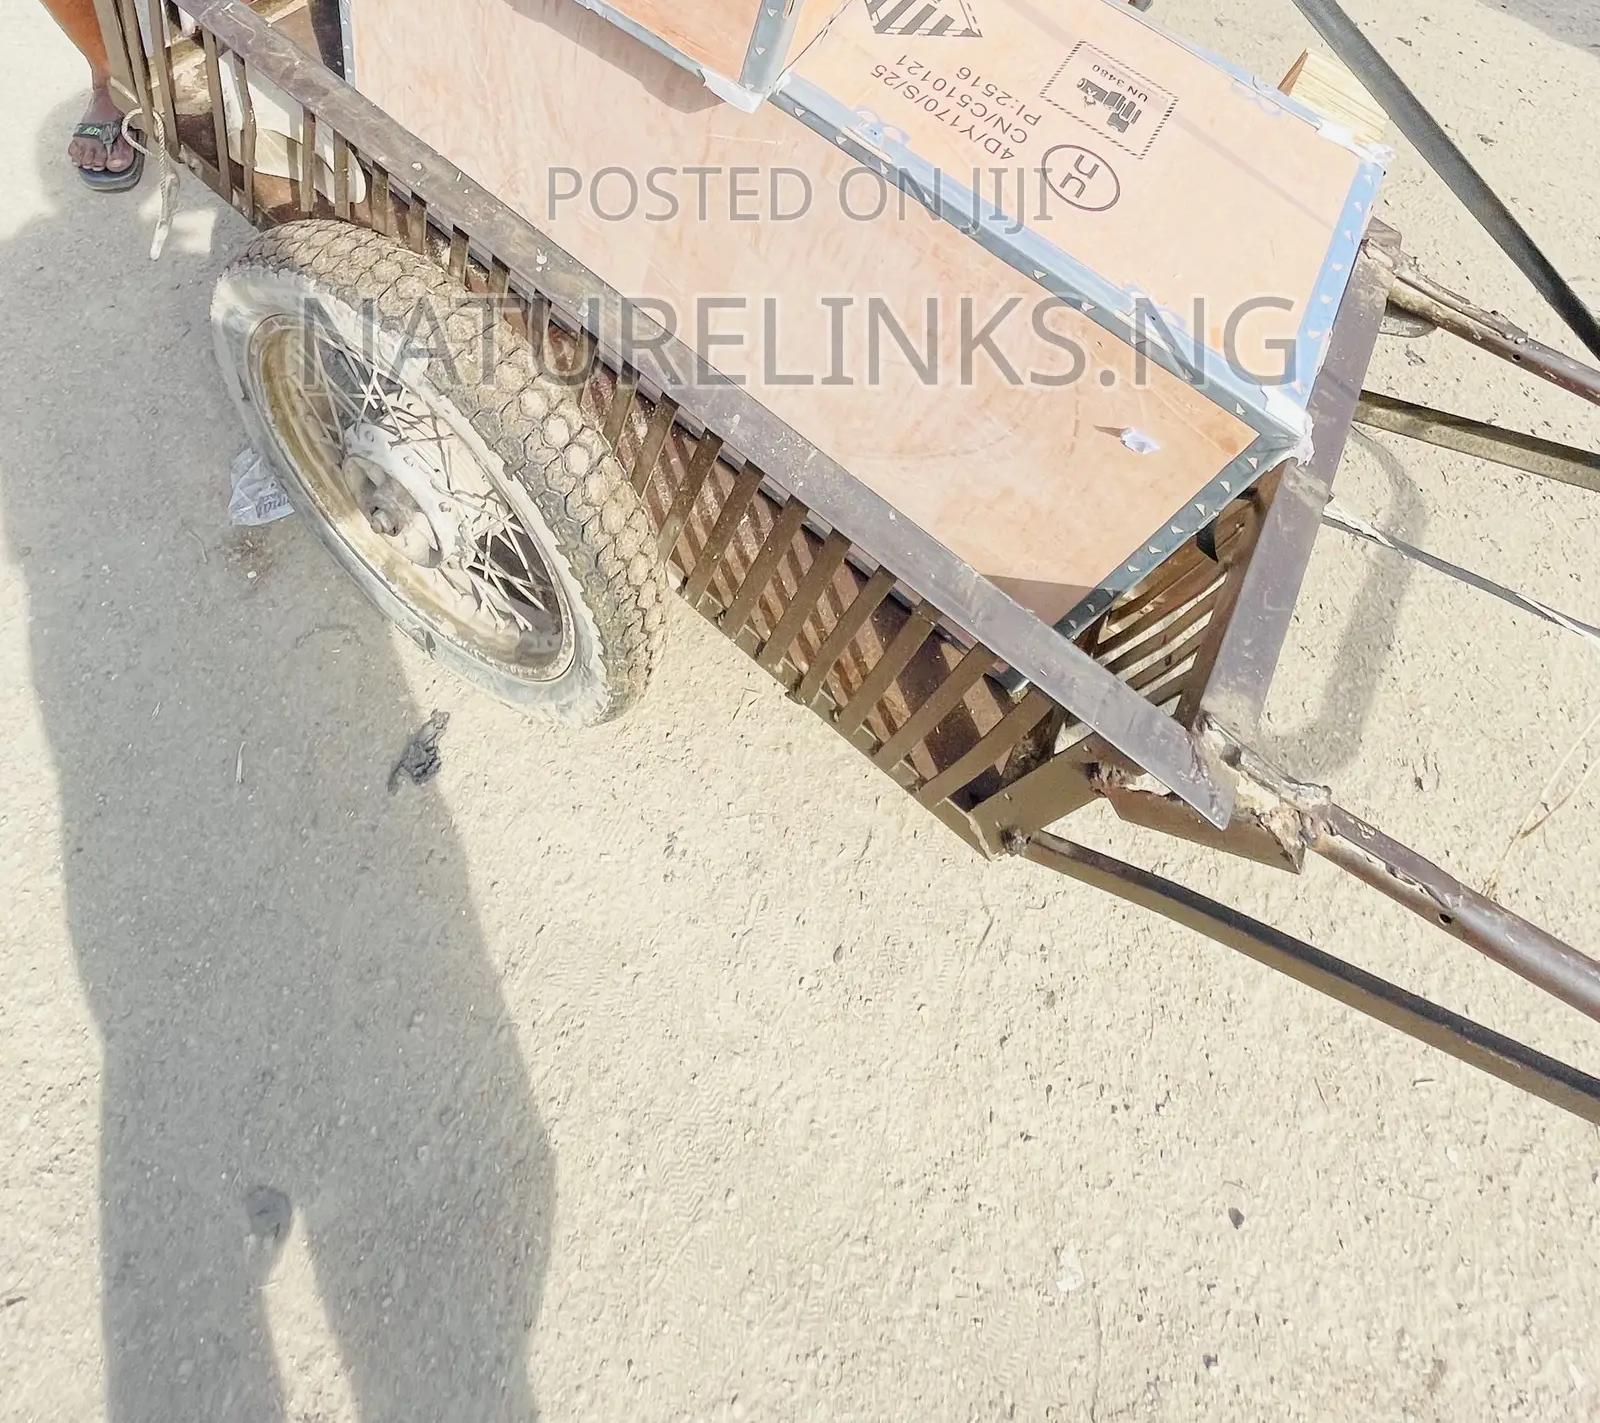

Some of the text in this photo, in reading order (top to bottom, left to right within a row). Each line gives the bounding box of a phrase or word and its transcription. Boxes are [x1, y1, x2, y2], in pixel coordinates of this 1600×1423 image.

[870, 64, 1015, 160] 4D/Y170/S/25
[896, 55, 1028, 144] CN/C510121
[956, 66, 1042, 126] PI:2516
[1091, 64, 1148, 103] UN 3480
